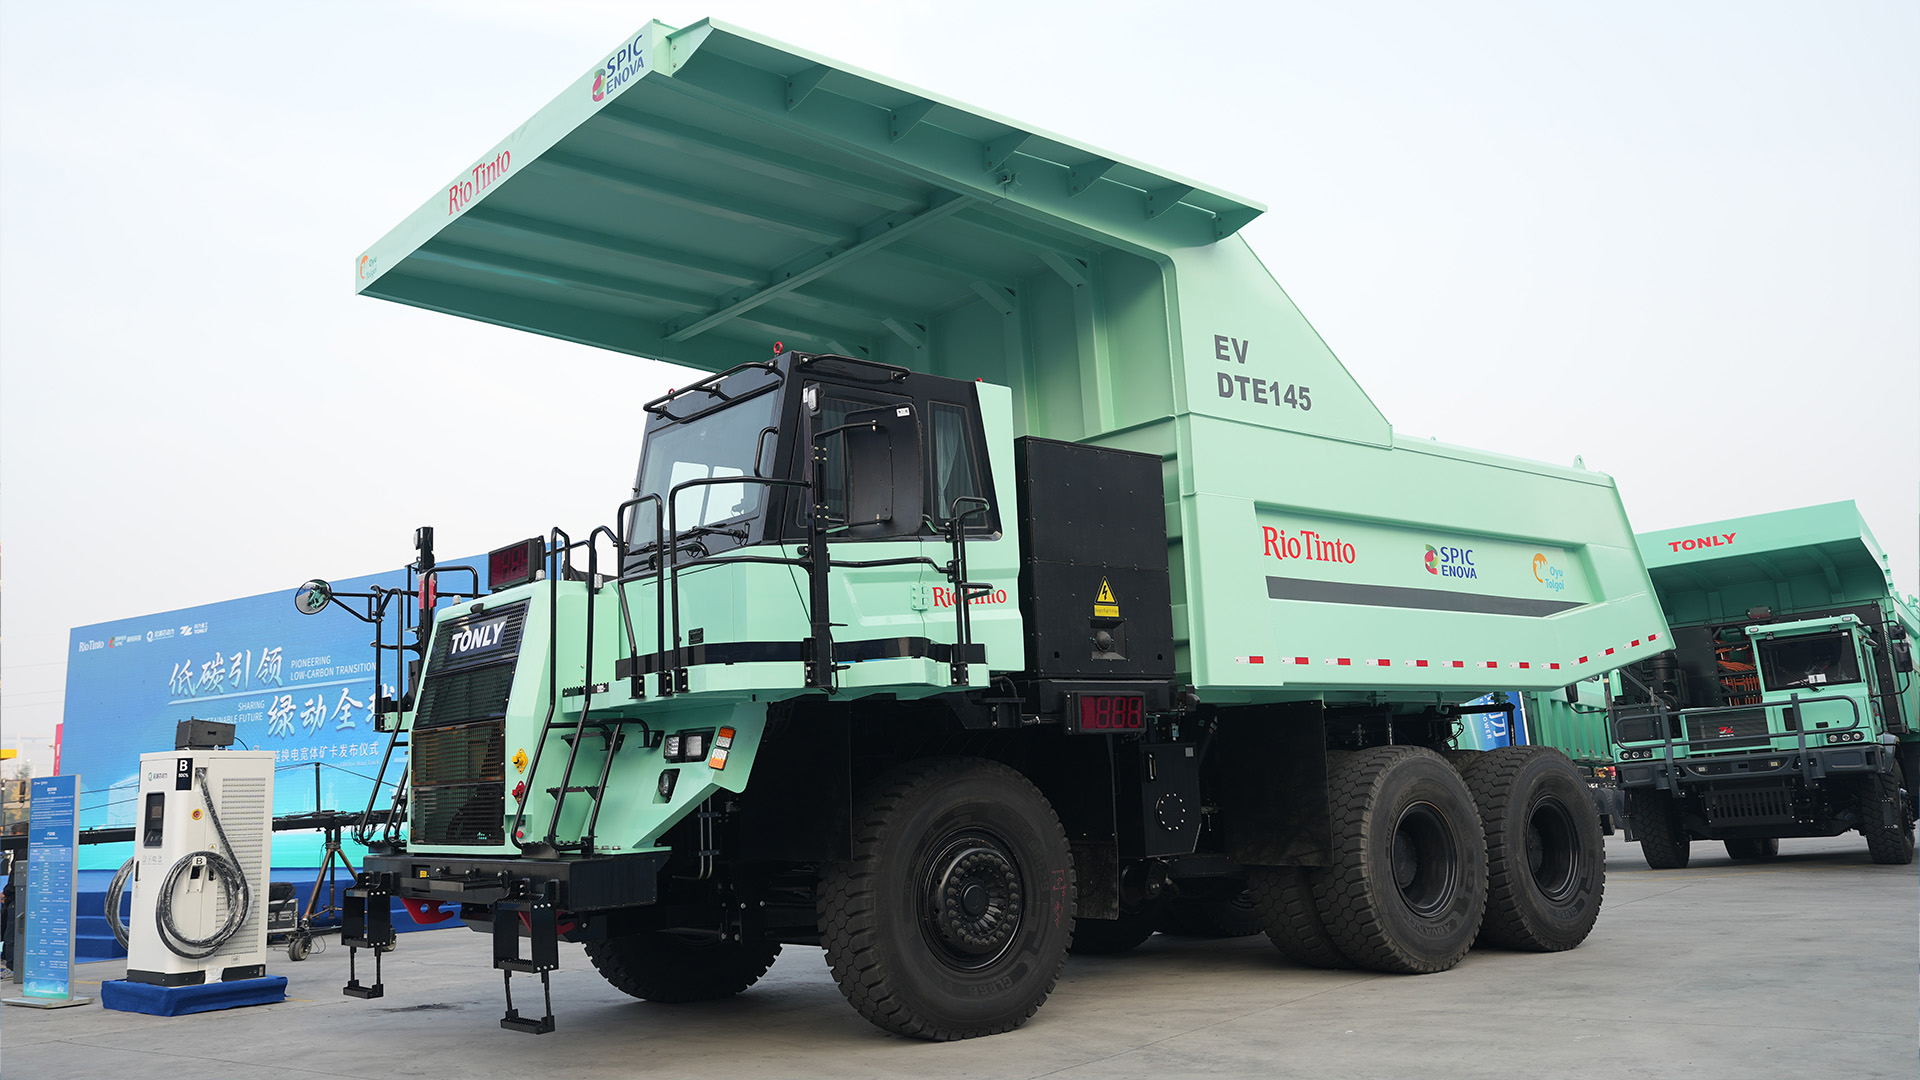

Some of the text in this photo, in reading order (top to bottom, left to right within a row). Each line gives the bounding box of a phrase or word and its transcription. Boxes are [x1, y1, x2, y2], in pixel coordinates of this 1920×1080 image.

[606, 34, 643, 78] SPIC
[606, 56, 644, 95] ENOVA
[1214, 334, 1249, 364] EV
[1217, 371, 1312, 412] DTE145
[1668, 532, 1737, 553] TONLY
[1440, 546, 1475, 567] SPIC
[1441, 564, 1478, 580] ENOVA
[1550, 566, 1563, 579] Oyu
[1545, 578, 1565, 592] Tolgoi
[451, 621, 505, 655] TONLY
[168, 647, 283, 697] 低碳引领
[290, 662, 377, 681] LOW-CARBON TRANSITION
[291, 655, 331, 669] PIONEERING
[238, 700, 265, 711] SHARING
[239, 712, 263, 723] FUTURE
[180, 760, 188, 771] B
